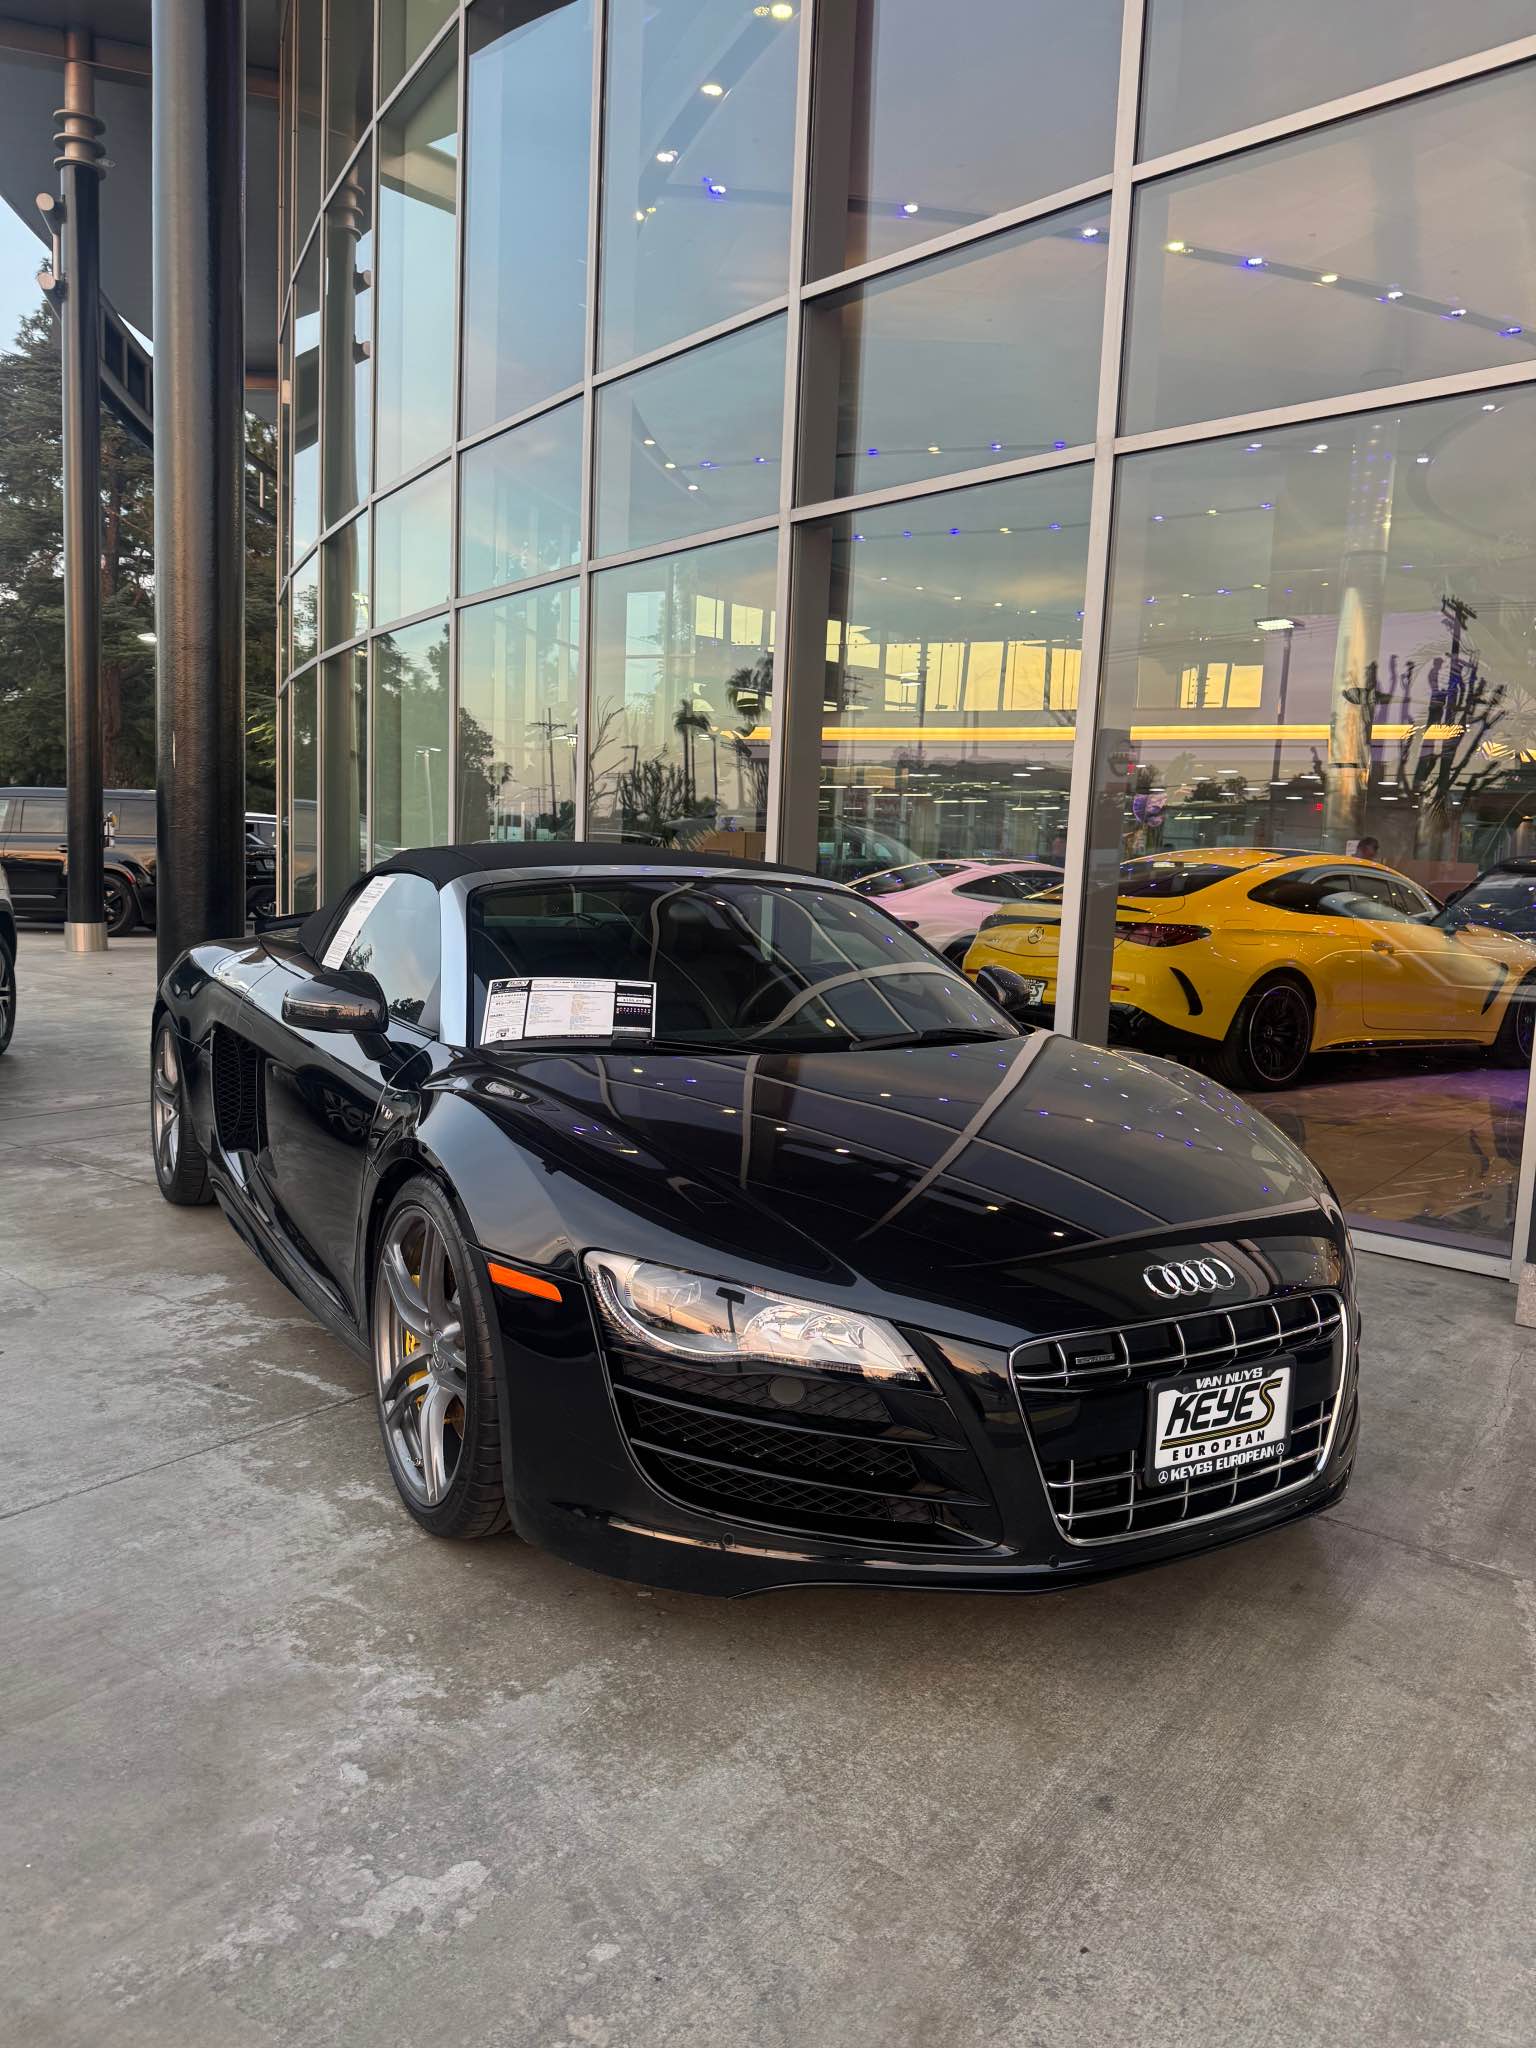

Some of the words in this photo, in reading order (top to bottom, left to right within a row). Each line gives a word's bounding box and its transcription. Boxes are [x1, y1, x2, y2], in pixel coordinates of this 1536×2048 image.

[1196, 1375, 1222, 1389] VAN
[1225, 1367, 1263, 1383] NUYS
[1164, 1377, 1283, 1438] KEYES
[1173, 1430, 1265, 1461] EUROPEAN
[1170, 1461, 1212, 1481] KEYES
[1216, 1445, 1275, 1470] EUROPEAN
